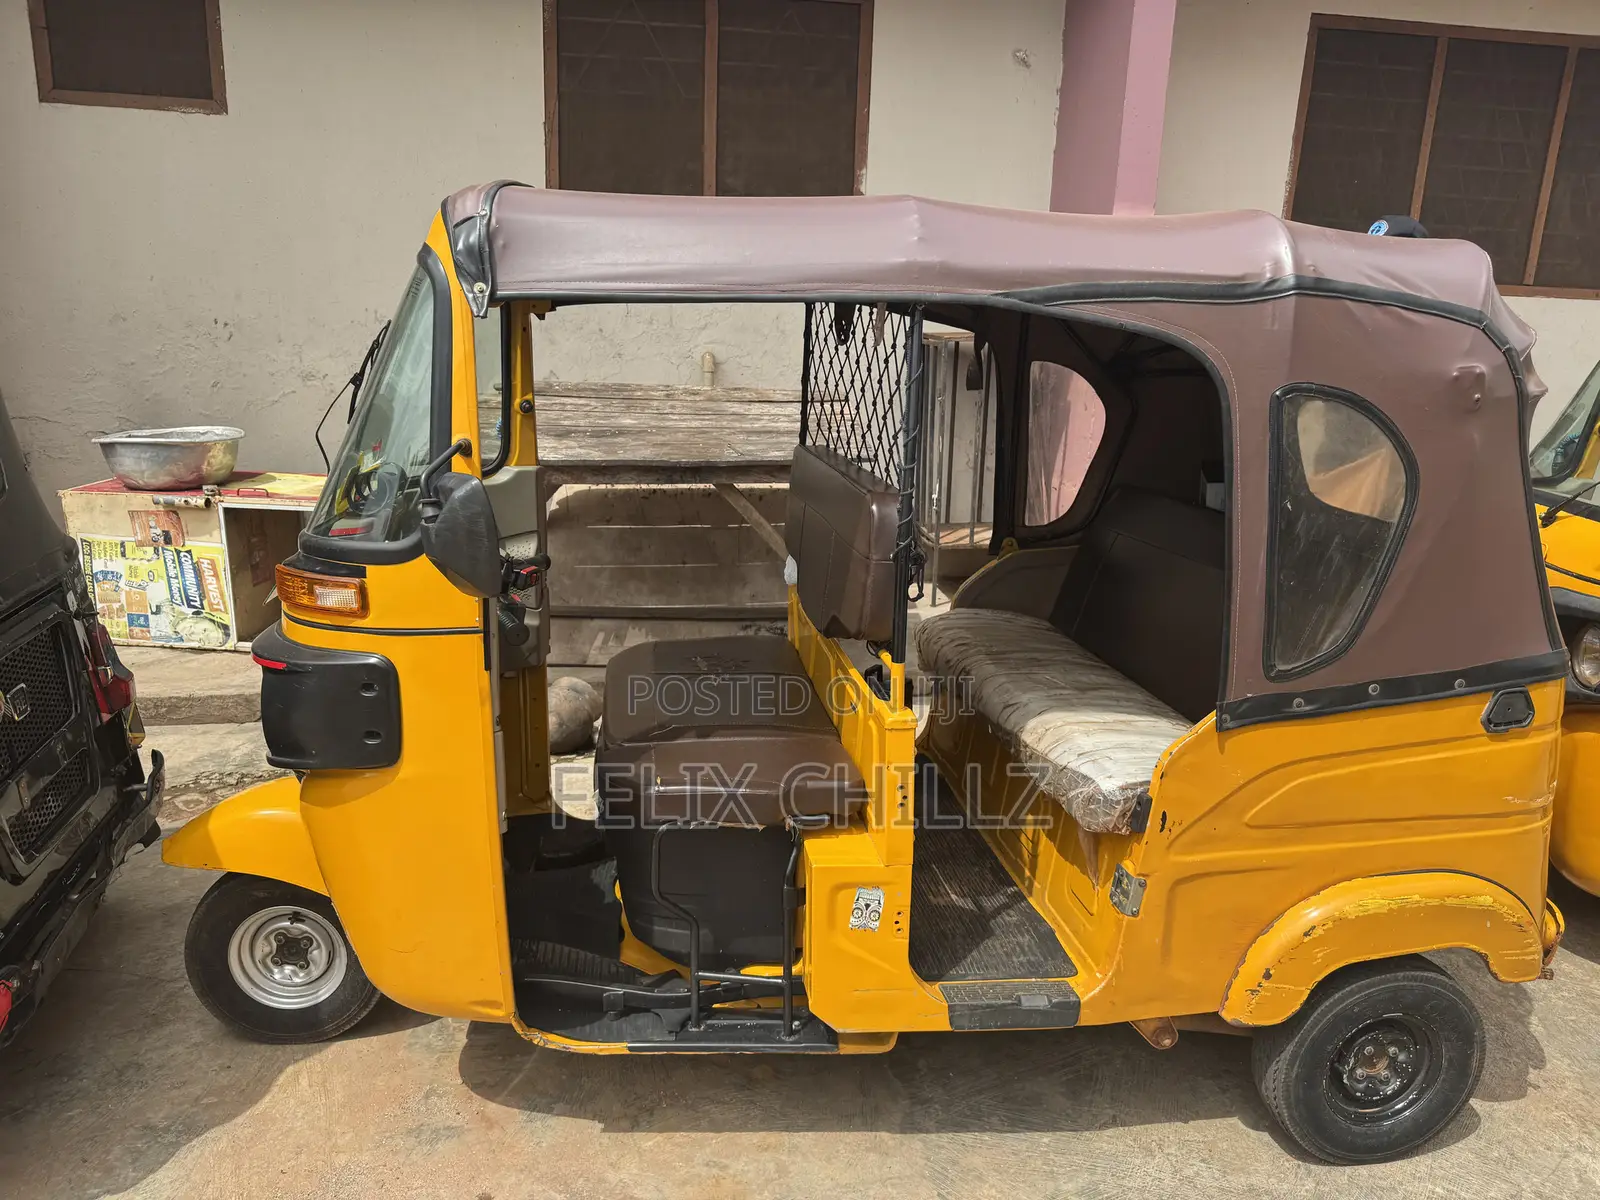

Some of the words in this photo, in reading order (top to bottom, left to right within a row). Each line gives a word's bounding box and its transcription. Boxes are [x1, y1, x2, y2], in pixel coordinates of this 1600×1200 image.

[164, 550, 177, 580] Mobile
[180, 552, 201, 609] COMMUNITY
[200, 558, 224, 612] HARVEST
[170, 579, 182, 606] Money
